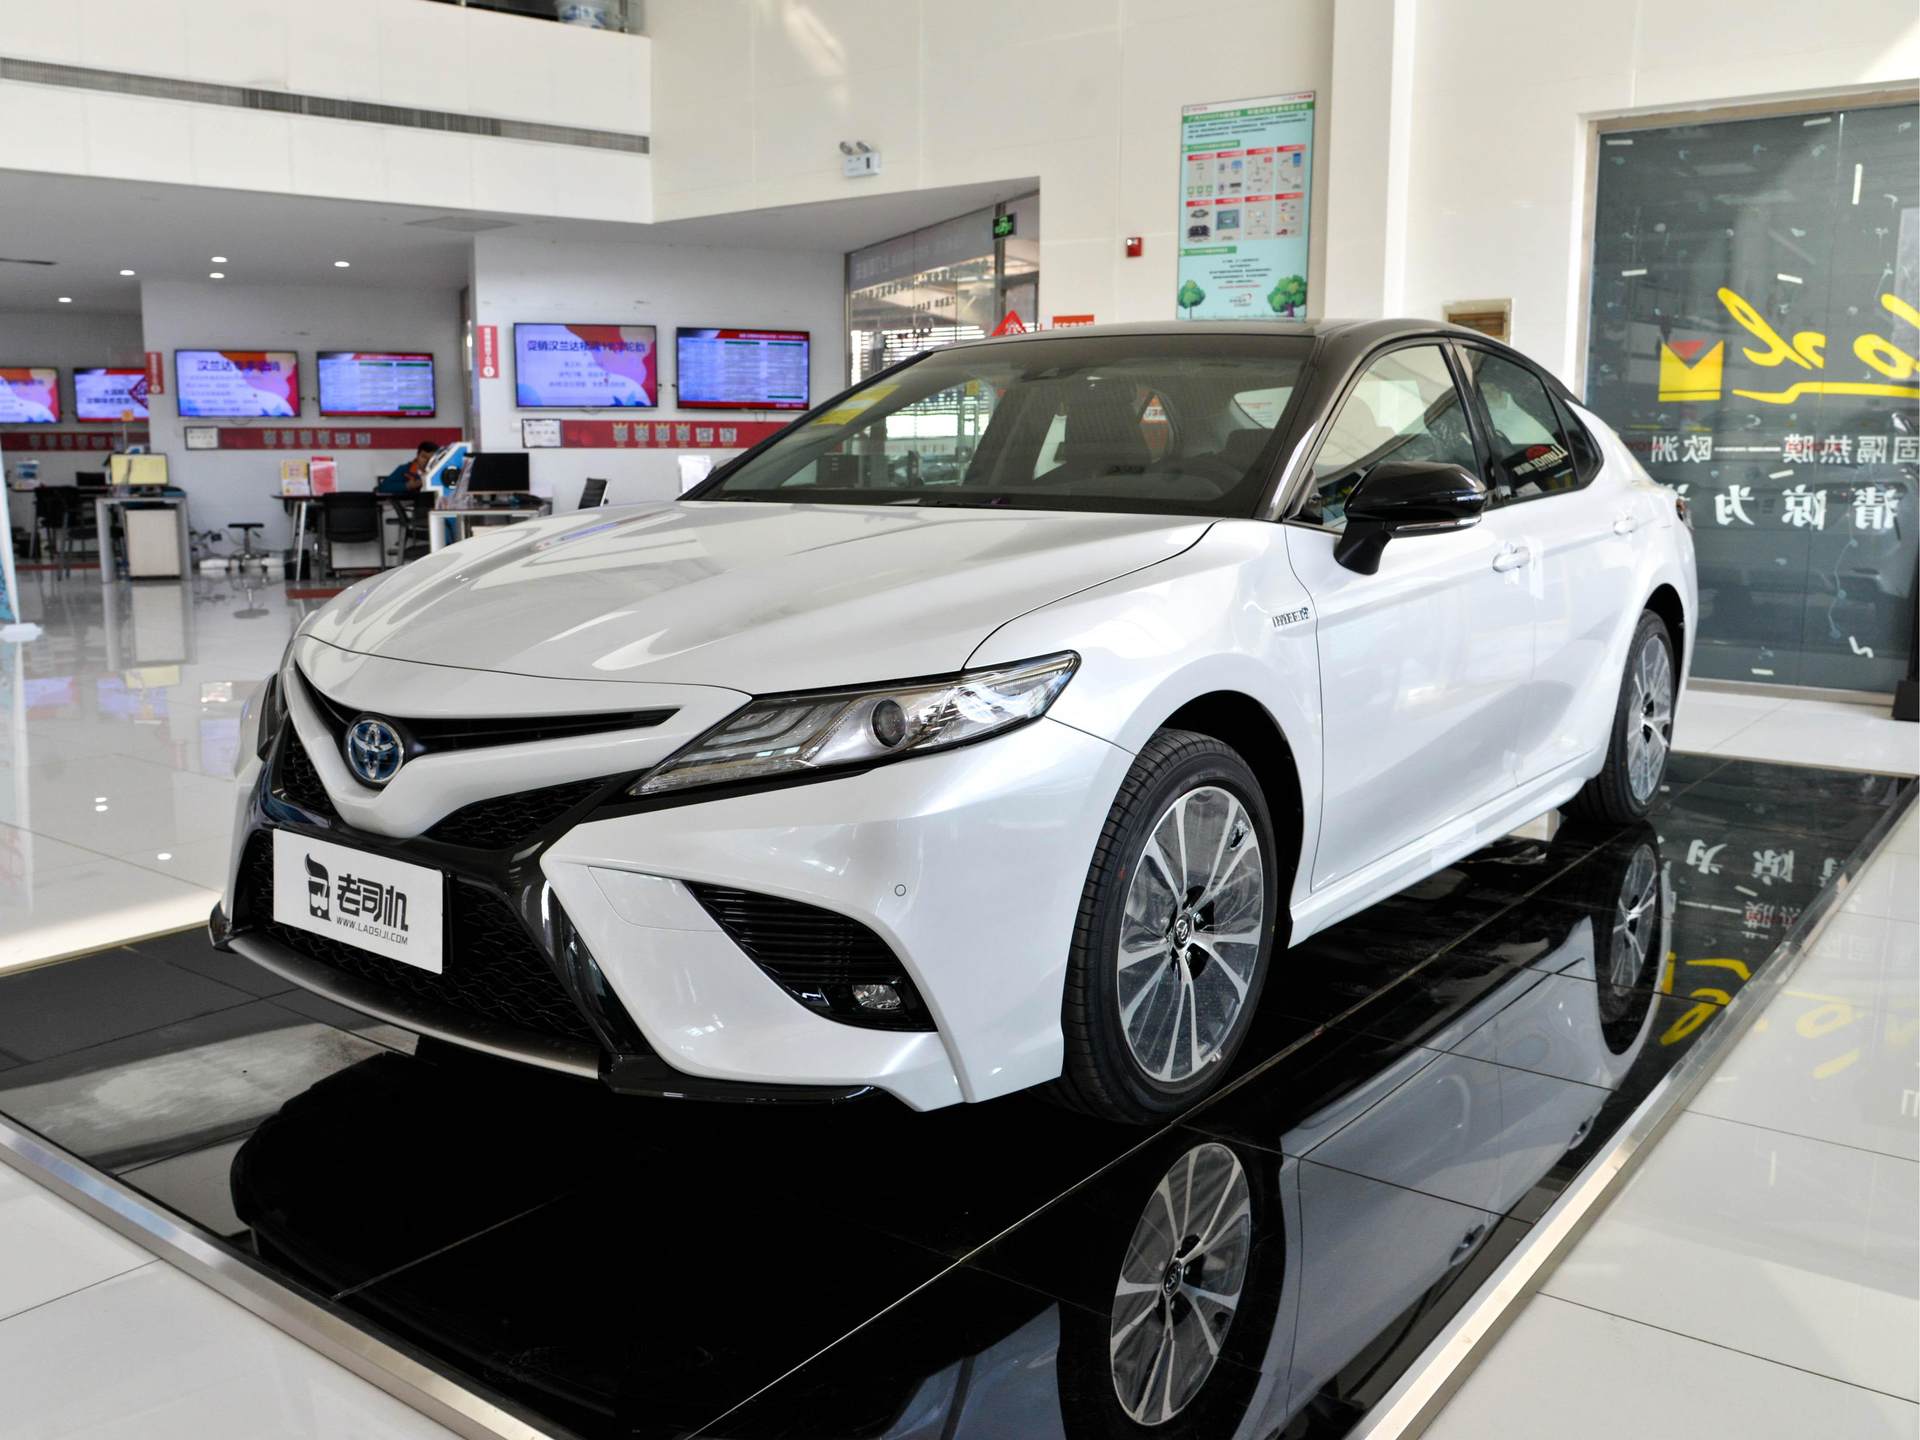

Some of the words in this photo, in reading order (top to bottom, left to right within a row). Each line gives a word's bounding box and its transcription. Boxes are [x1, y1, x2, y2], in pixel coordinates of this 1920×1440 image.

[337, 873, 409, 932] 老司机
[337, 917, 409, 945] WWW.LAOSIJI.COM
